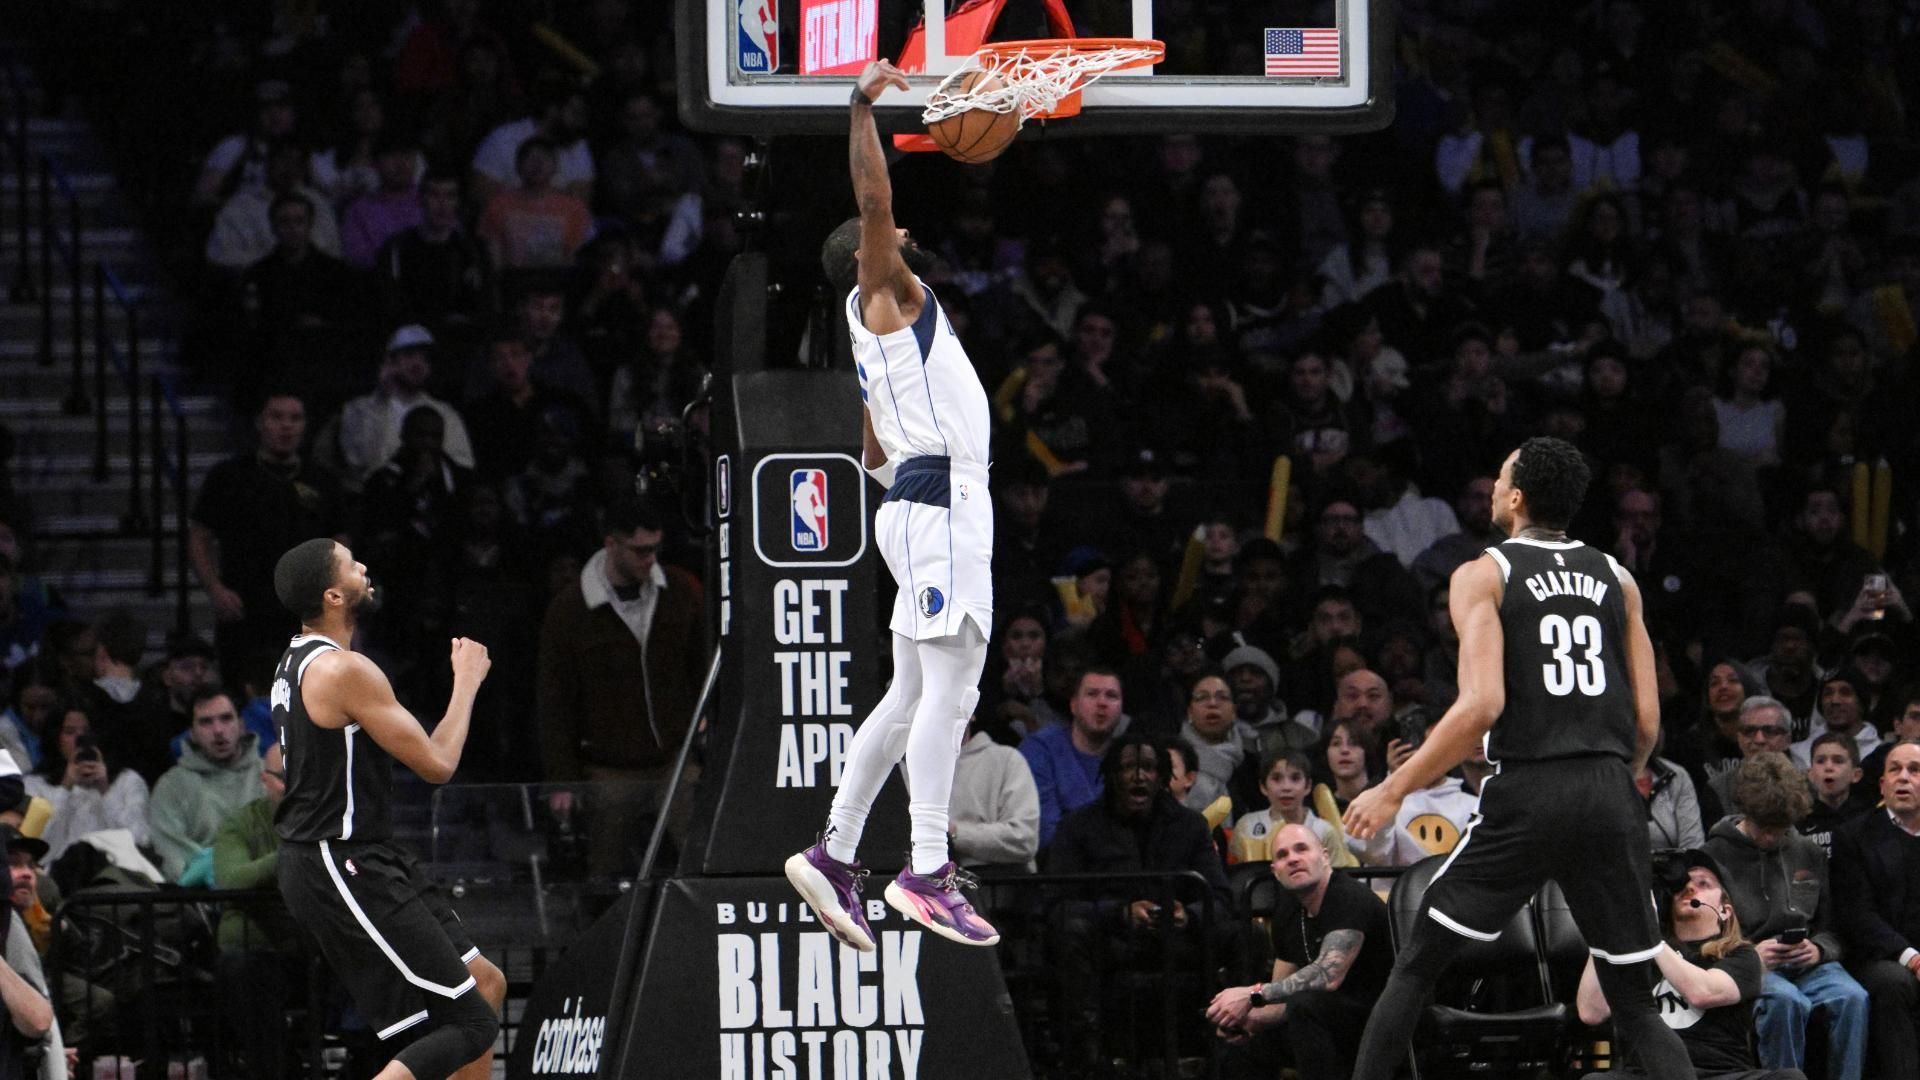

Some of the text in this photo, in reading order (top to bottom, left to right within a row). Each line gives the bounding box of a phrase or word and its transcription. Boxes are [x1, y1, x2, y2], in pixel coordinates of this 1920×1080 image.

[743, 52, 763, 67] NBA
[796, 532, 815, 546] NBA
[773, 578, 849, 645] GET
[1525, 570, 1608, 606] CLAXTON
[773, 651, 853, 716] THE
[1539, 614, 1607, 696] 33
[775, 723, 854, 788] APP
[717, 902, 815, 924] BUIL
[717, 930, 925, 1029] BLACK
[532, 996, 606, 1074] coinbase
[719, 1029, 925, 1080] HISTORY
